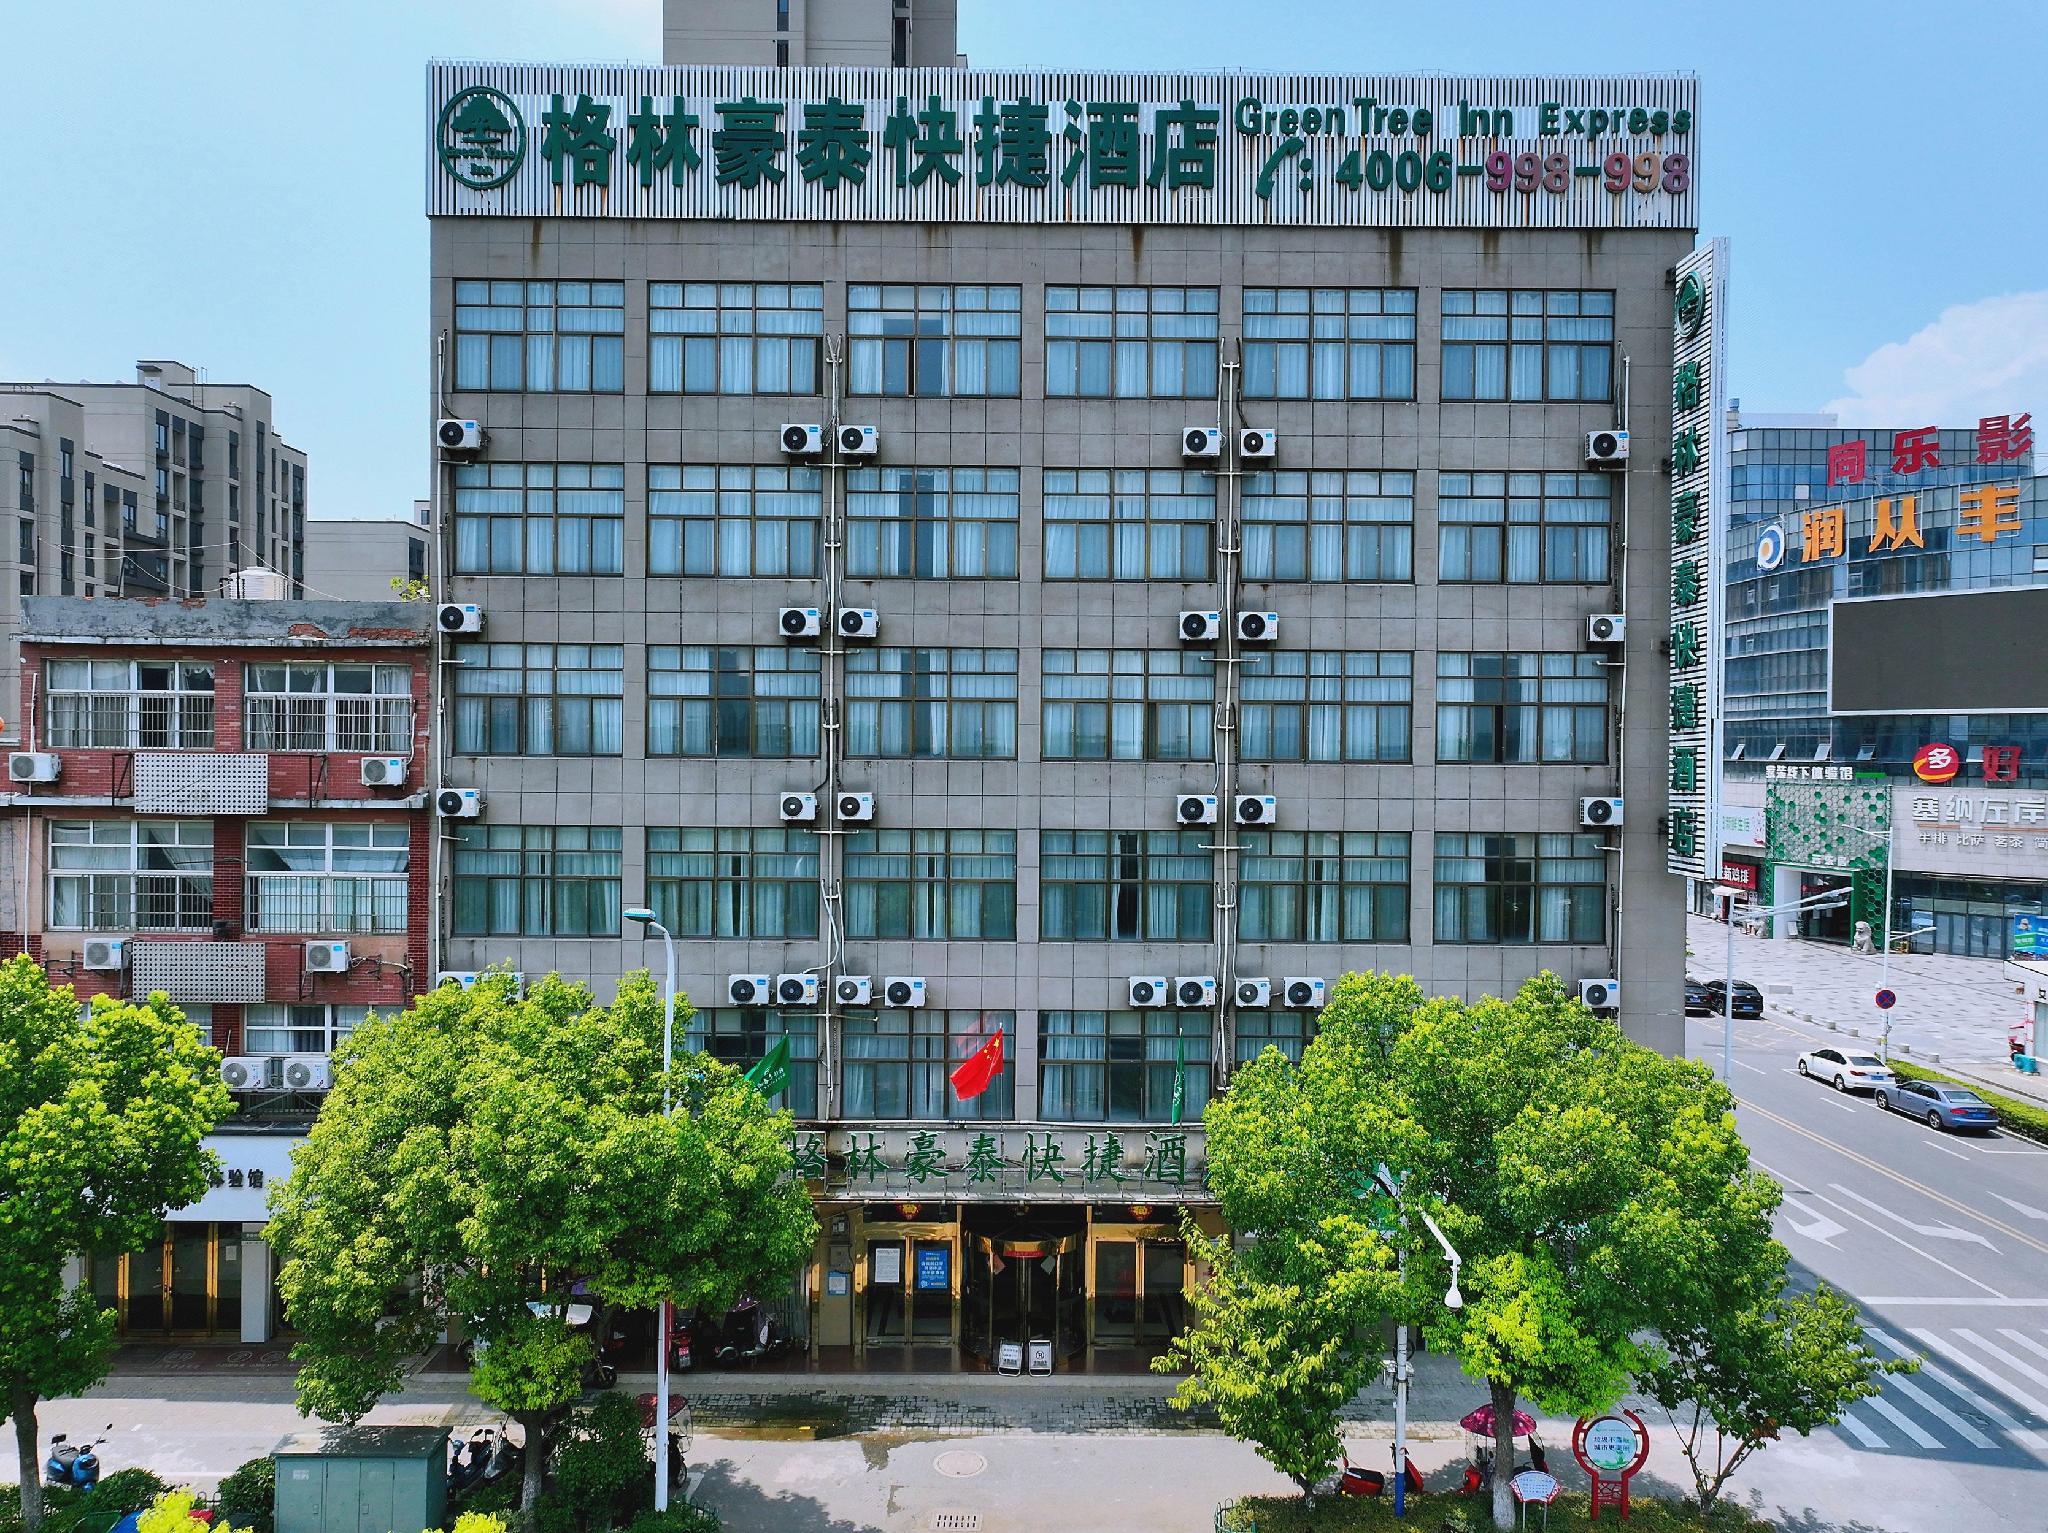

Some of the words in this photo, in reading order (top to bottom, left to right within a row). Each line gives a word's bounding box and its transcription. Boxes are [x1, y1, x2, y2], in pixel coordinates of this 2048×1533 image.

[541, 93, 1220, 189] 格林豪泰快捷酒店
[1459, 99, 1513, 137] Inn
[1539, 102, 1692, 141] Express
[1336, 149, 1690, 194] 4006-998-998
[1672, 360, 1701, 856] 格林豪泰快捷酒店
[1721, 865, 1750, 884] 新鸡排
[790, 1130, 1212, 1185] 格林豪泰快捷酒
